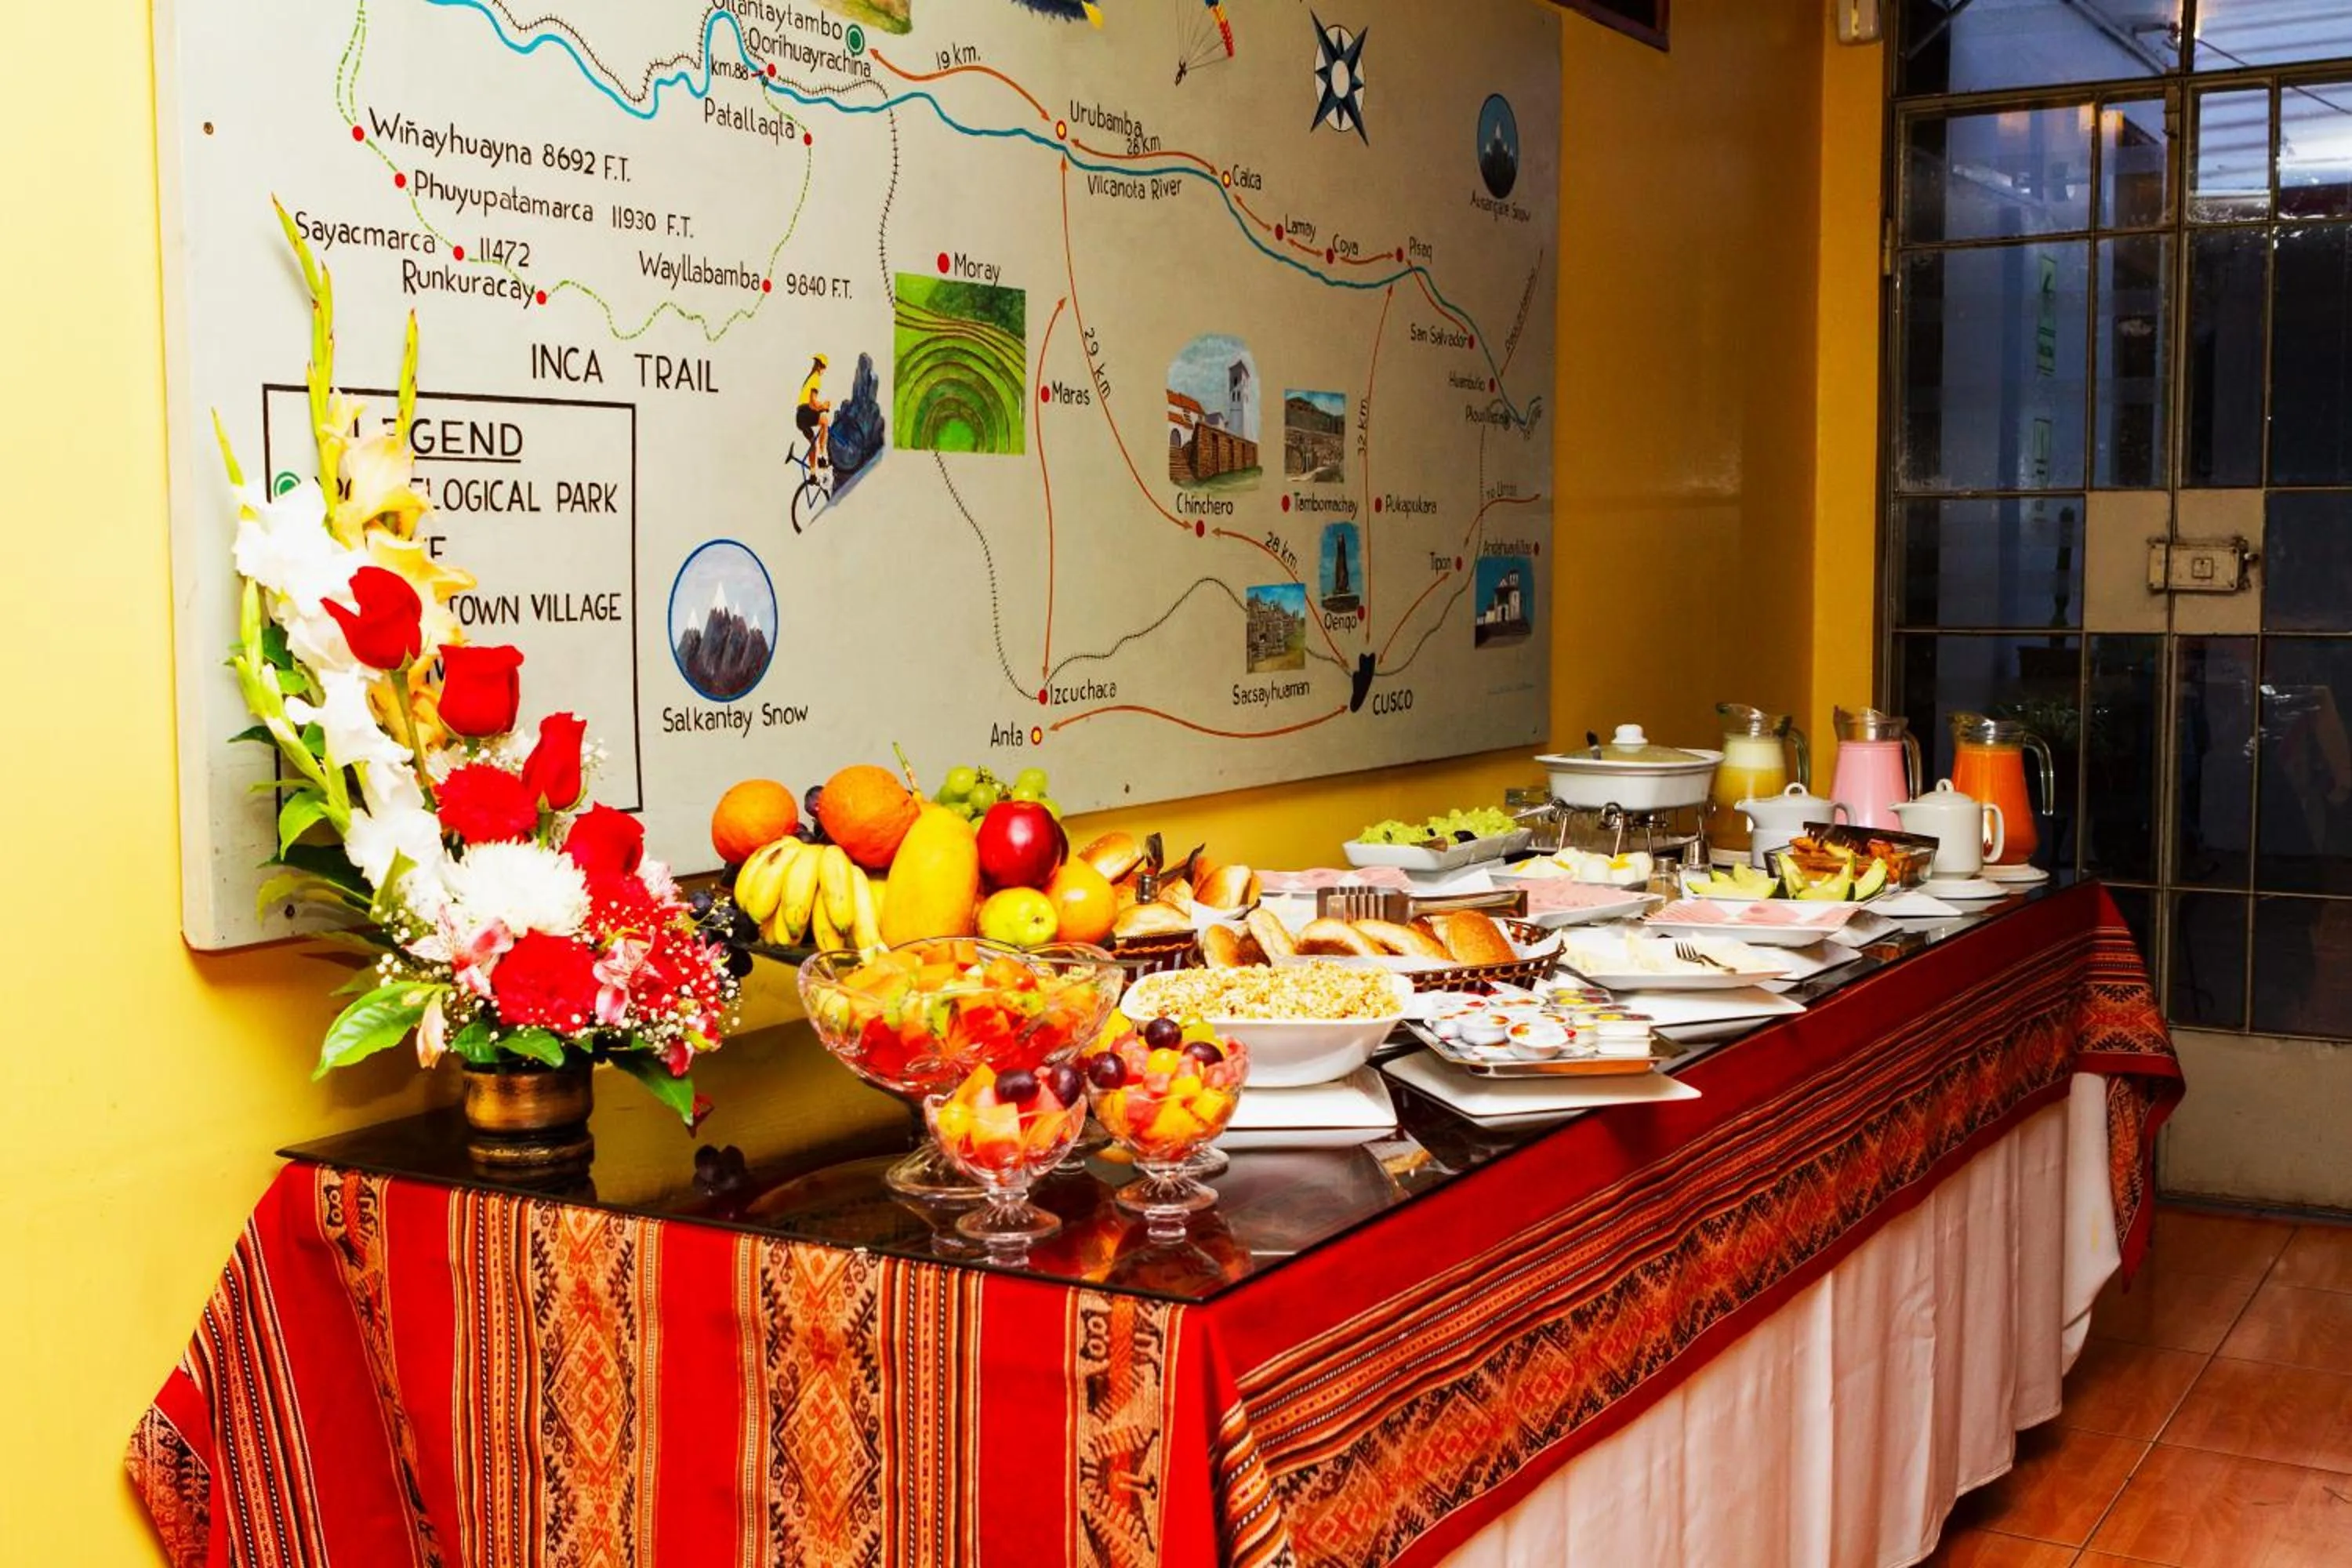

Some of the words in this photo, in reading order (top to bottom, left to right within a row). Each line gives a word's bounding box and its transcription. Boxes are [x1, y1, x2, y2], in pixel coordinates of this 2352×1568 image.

[936, 49, 950, 70] 19
[1069, 100, 1142, 138] Urubamba
[368, 107, 532, 168] Wiñayhuayna
[543, 143, 596, 175] 8692
[604, 155, 631, 182] F.T.
[1127, 137, 1140, 156] 28
[1087, 175, 1145, 200] Vilcanota
[1152, 178, 1181, 200] River
[1233, 165, 1261, 191] Calca
[414, 170, 593, 223] Phuyupatamarca
[612, 204, 656, 232] 11930
[666, 215, 694, 238] F.T.
[296, 211, 436, 254] Sayacmarca
[1285, 214, 1316, 241] Lamay
[479, 237, 531, 268] 11472
[1333, 234, 1359, 256] Coya
[639, 251, 760, 291] Wayllabamba
[786, 274, 826, 296] 9840
[832, 279, 853, 299] F.T.
[954, 252, 1001, 283] Moray
[401, 260, 535, 310] Runkuracay
[532, 343, 604, 384] INCA
[633, 353, 719, 393] TRAIL
[1051, 381, 1091, 406] Maras
[557, 481, 619, 514] PARK
[1176, 493, 1234, 516] Chinchero
[532, 593, 622, 622] VILLAGE
[1049, 681, 1118, 706] Izcuchaca
[1232, 681, 1310, 712] Sacsayhuaman
[1373, 689, 1413, 715] CUSCO
[662, 704, 753, 739] Salkantay
[761, 703, 808, 728] Snow
[989, 721, 1024, 749] Anta
